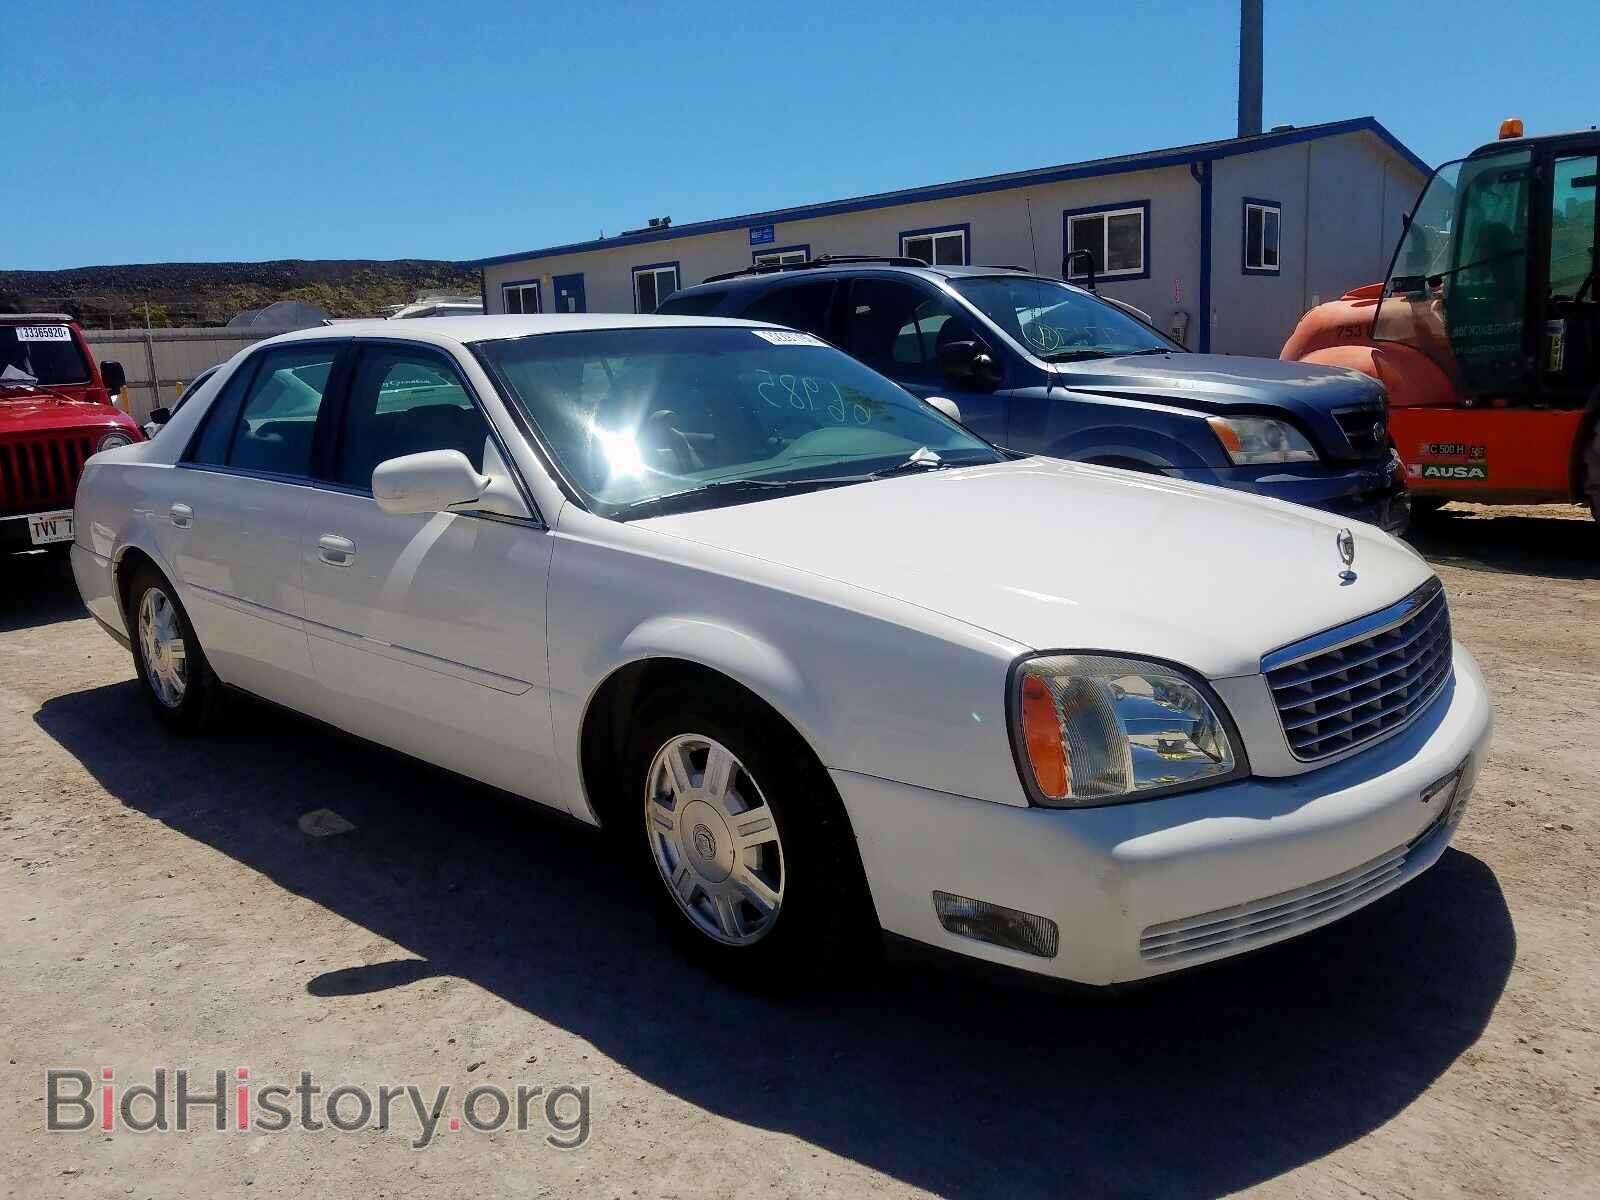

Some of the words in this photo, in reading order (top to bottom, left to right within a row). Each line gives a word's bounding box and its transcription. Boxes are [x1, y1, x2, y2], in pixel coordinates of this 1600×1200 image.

[23, 327, 64, 338] 33365920
[1424, 466, 1485, 478] AUSA
[32, 520, 57, 538] TVV
